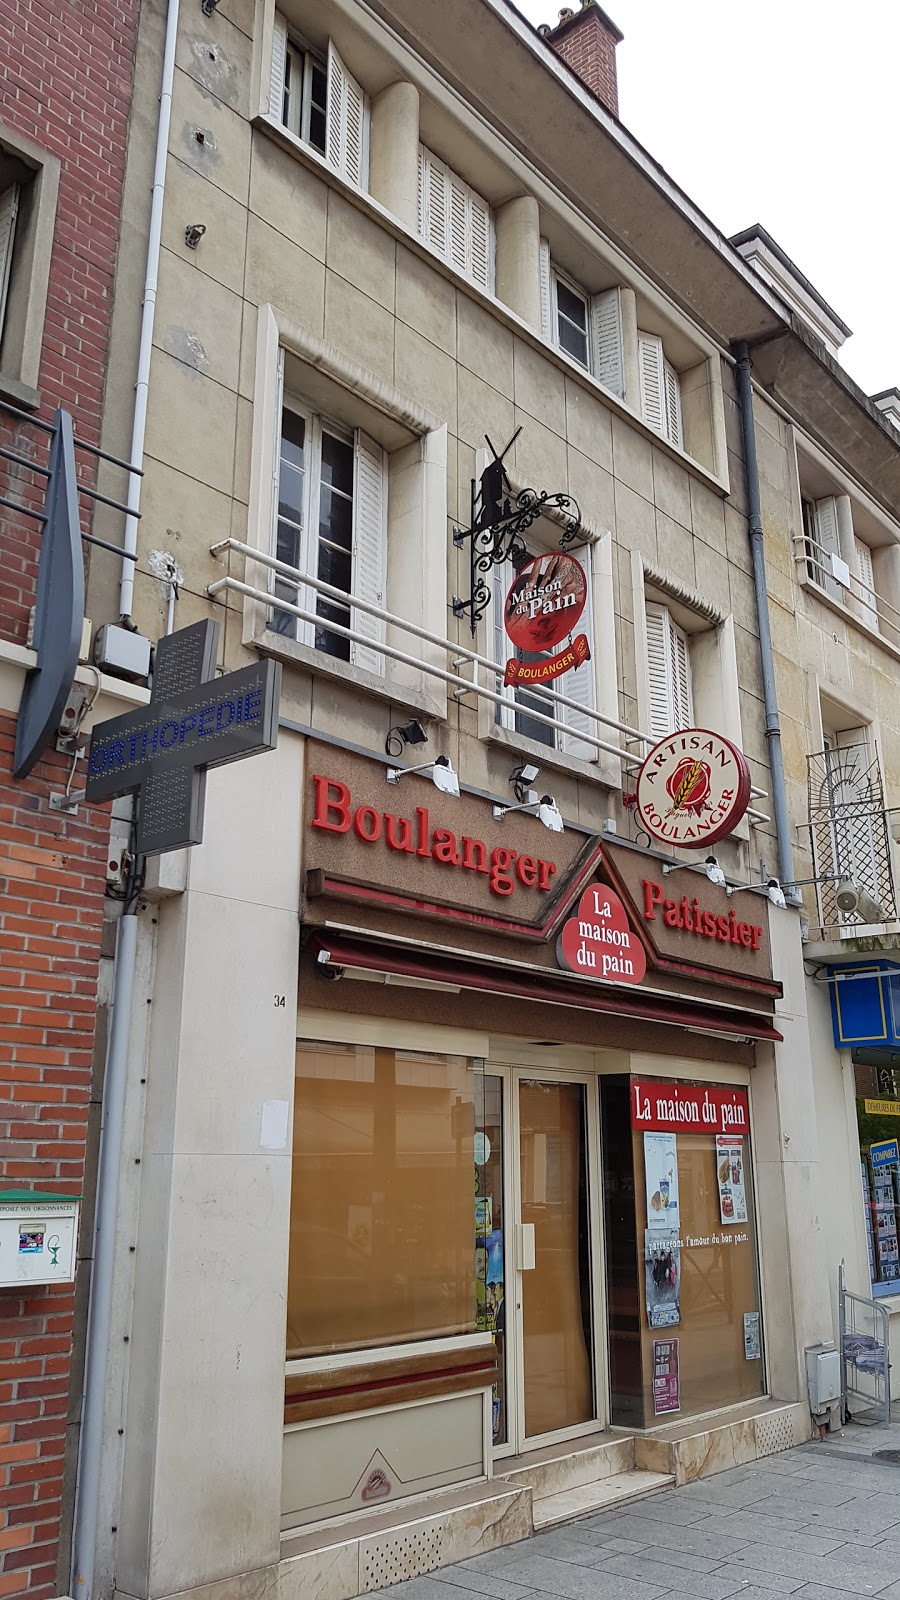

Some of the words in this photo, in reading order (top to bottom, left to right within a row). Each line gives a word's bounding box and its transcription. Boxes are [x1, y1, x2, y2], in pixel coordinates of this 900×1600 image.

[511, 580, 562, 605] Maison
[516, 604, 529, 614] du
[528, 591, 577, 619] Pain
[518, 652, 575, 678] BOULANGER
[90, 690, 263, 772] ORTHOPEDIE
[645, 736, 731, 785] ARTISAN
[643, 788, 734, 839] BOULANGER
[312, 774, 557, 896] Boulanger
[592, 890, 612, 918] La
[642, 879, 763, 950] Patissier
[578, 919, 631, 949] maison
[576, 940, 597, 968] du
[602, 950, 635, 976] pain
[273, 994, 286, 1008] 34
[634, 1085, 652, 1120] La
[656, 1089, 700, 1122] maison
[702, 1090, 717, 1123] du
[720, 1094, 745, 1132] pain
[872, 1147, 897, 1163] COMPAREZ
[33, 1204, 73, 1212] ORDONNANCES
[648, 1239, 684, 1255] partageons
[686, 1235, 710, 1247] l'amour
[711, 1232, 720, 1244] du
[721, 1232, 732, 1243] bon
